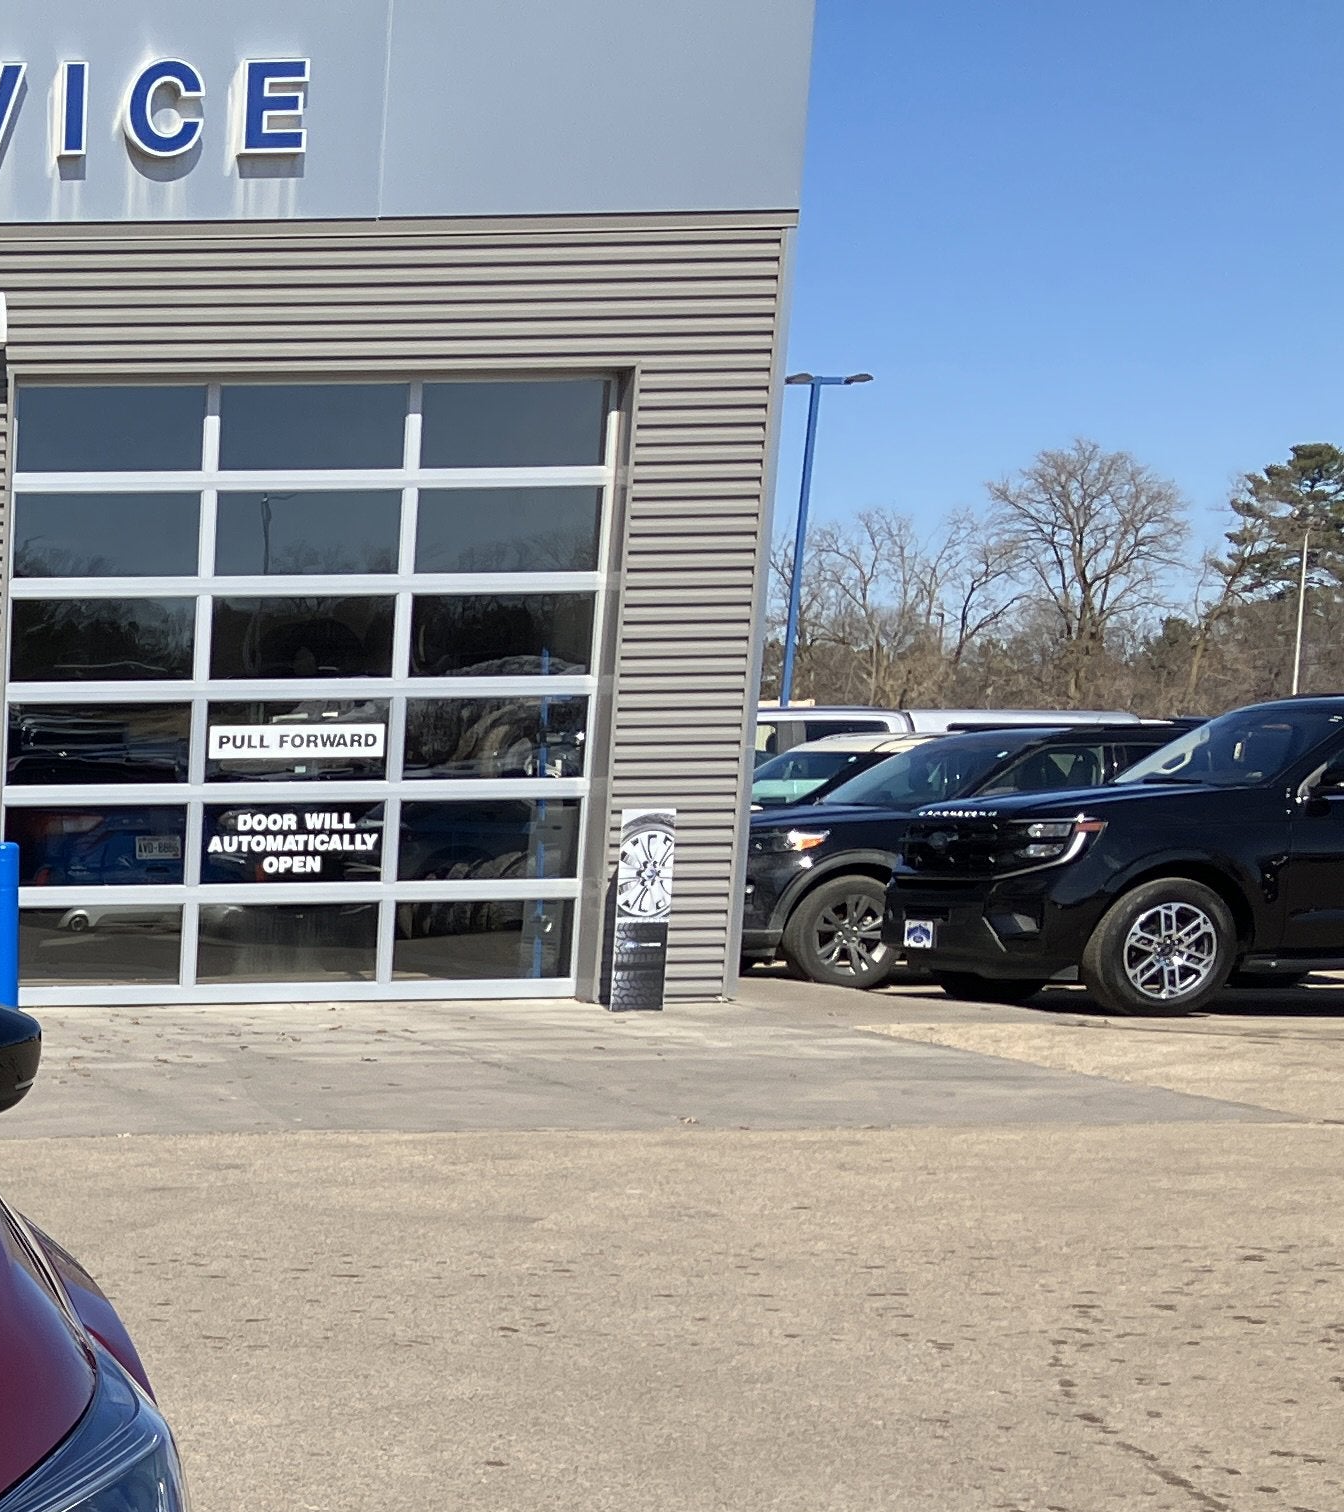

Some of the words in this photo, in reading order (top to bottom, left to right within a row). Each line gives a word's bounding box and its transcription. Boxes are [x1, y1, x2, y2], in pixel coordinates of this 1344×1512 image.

[217, 734, 271, 750] PULL
[278, 733, 378, 749] FORWARD
[237, 813, 297, 831] DOOR
[304, 812, 356, 830] WILL
[207, 833, 379, 853] AUTOMATICALLY
[262, 855, 322, 874] OPEN
